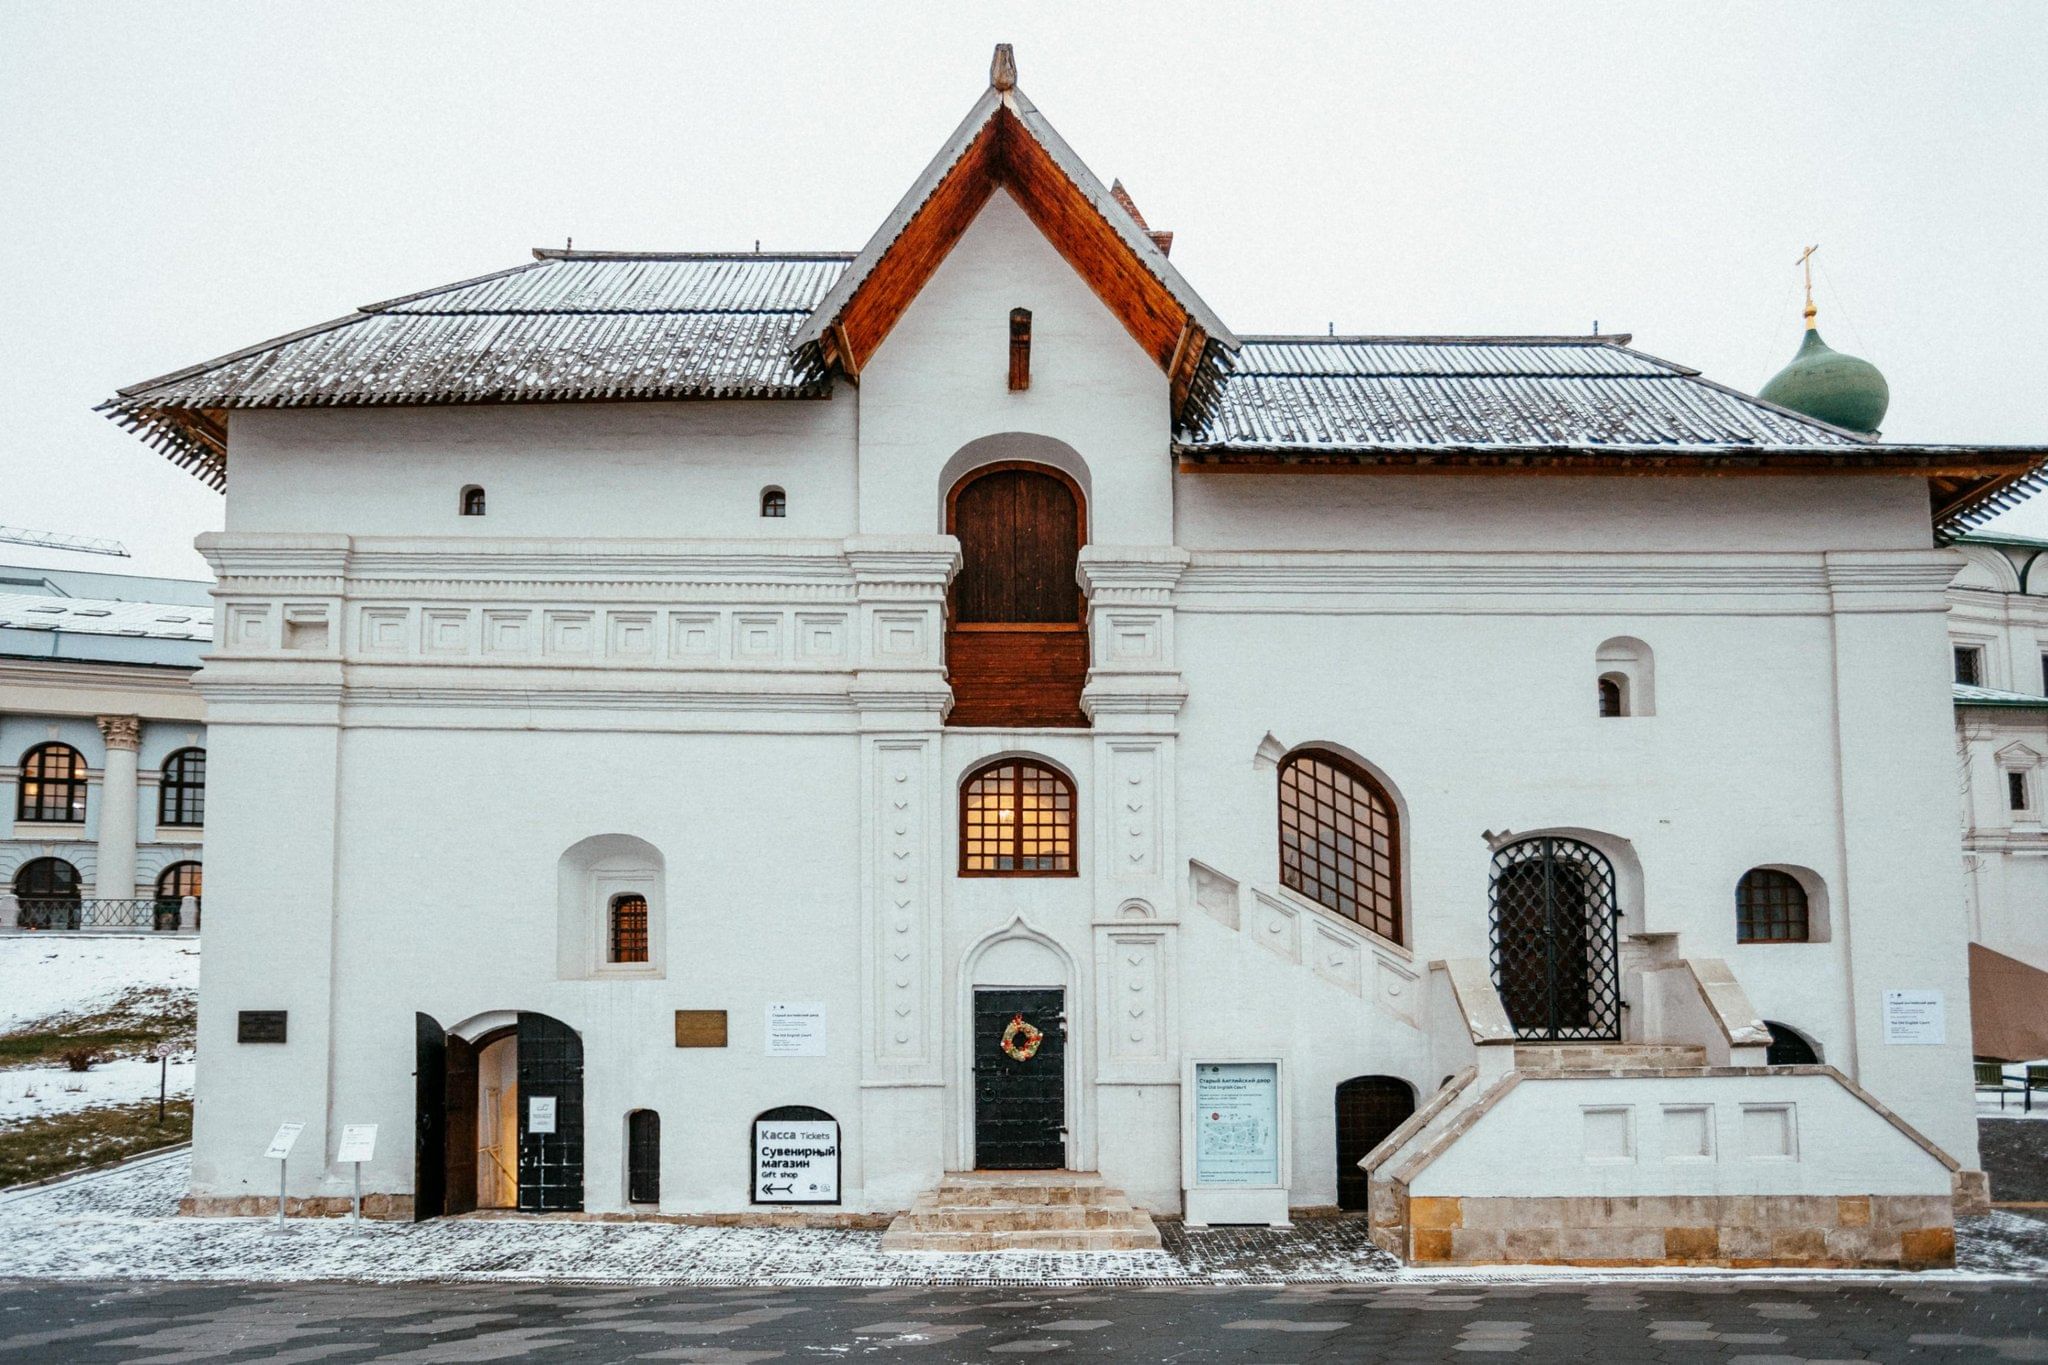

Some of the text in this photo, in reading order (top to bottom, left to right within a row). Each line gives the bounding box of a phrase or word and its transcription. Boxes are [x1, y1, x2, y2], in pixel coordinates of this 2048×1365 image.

[761, 1130, 830, 1140] Касса Tickets
[761, 1146, 835, 1158] Сувенирный
[761, 1160, 810, 1168] магазин
[780, 1171, 798, 1179] shop
